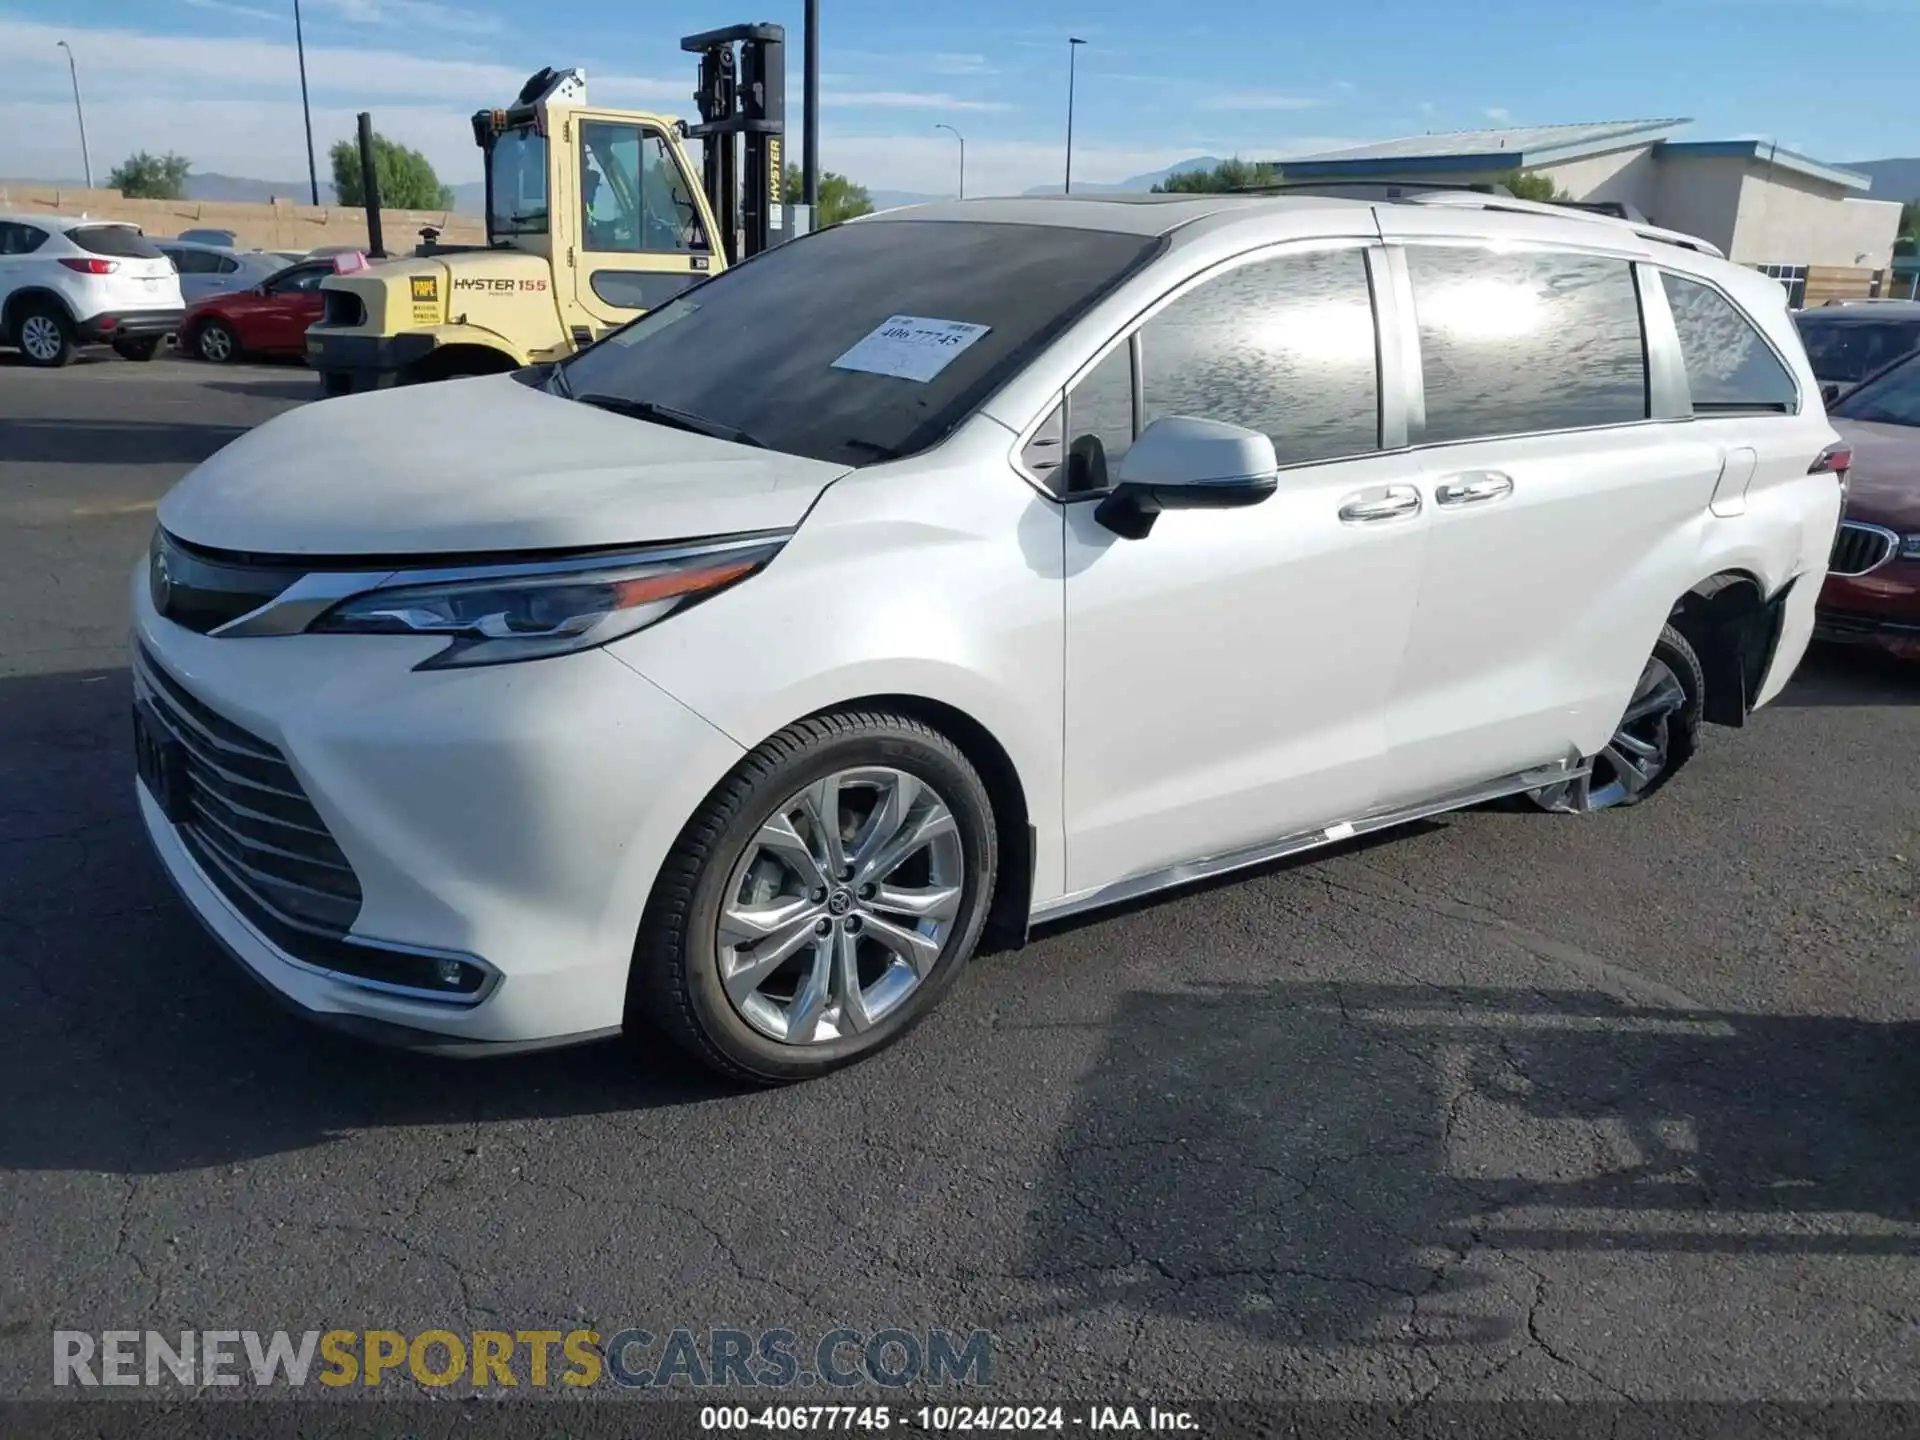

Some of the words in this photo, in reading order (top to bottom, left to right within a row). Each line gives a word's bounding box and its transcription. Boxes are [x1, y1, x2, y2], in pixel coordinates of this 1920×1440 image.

[769, 140, 781, 202] HYSTER
[454, 279, 515, 291] HYSTER
[518, 280, 547, 292] 155
